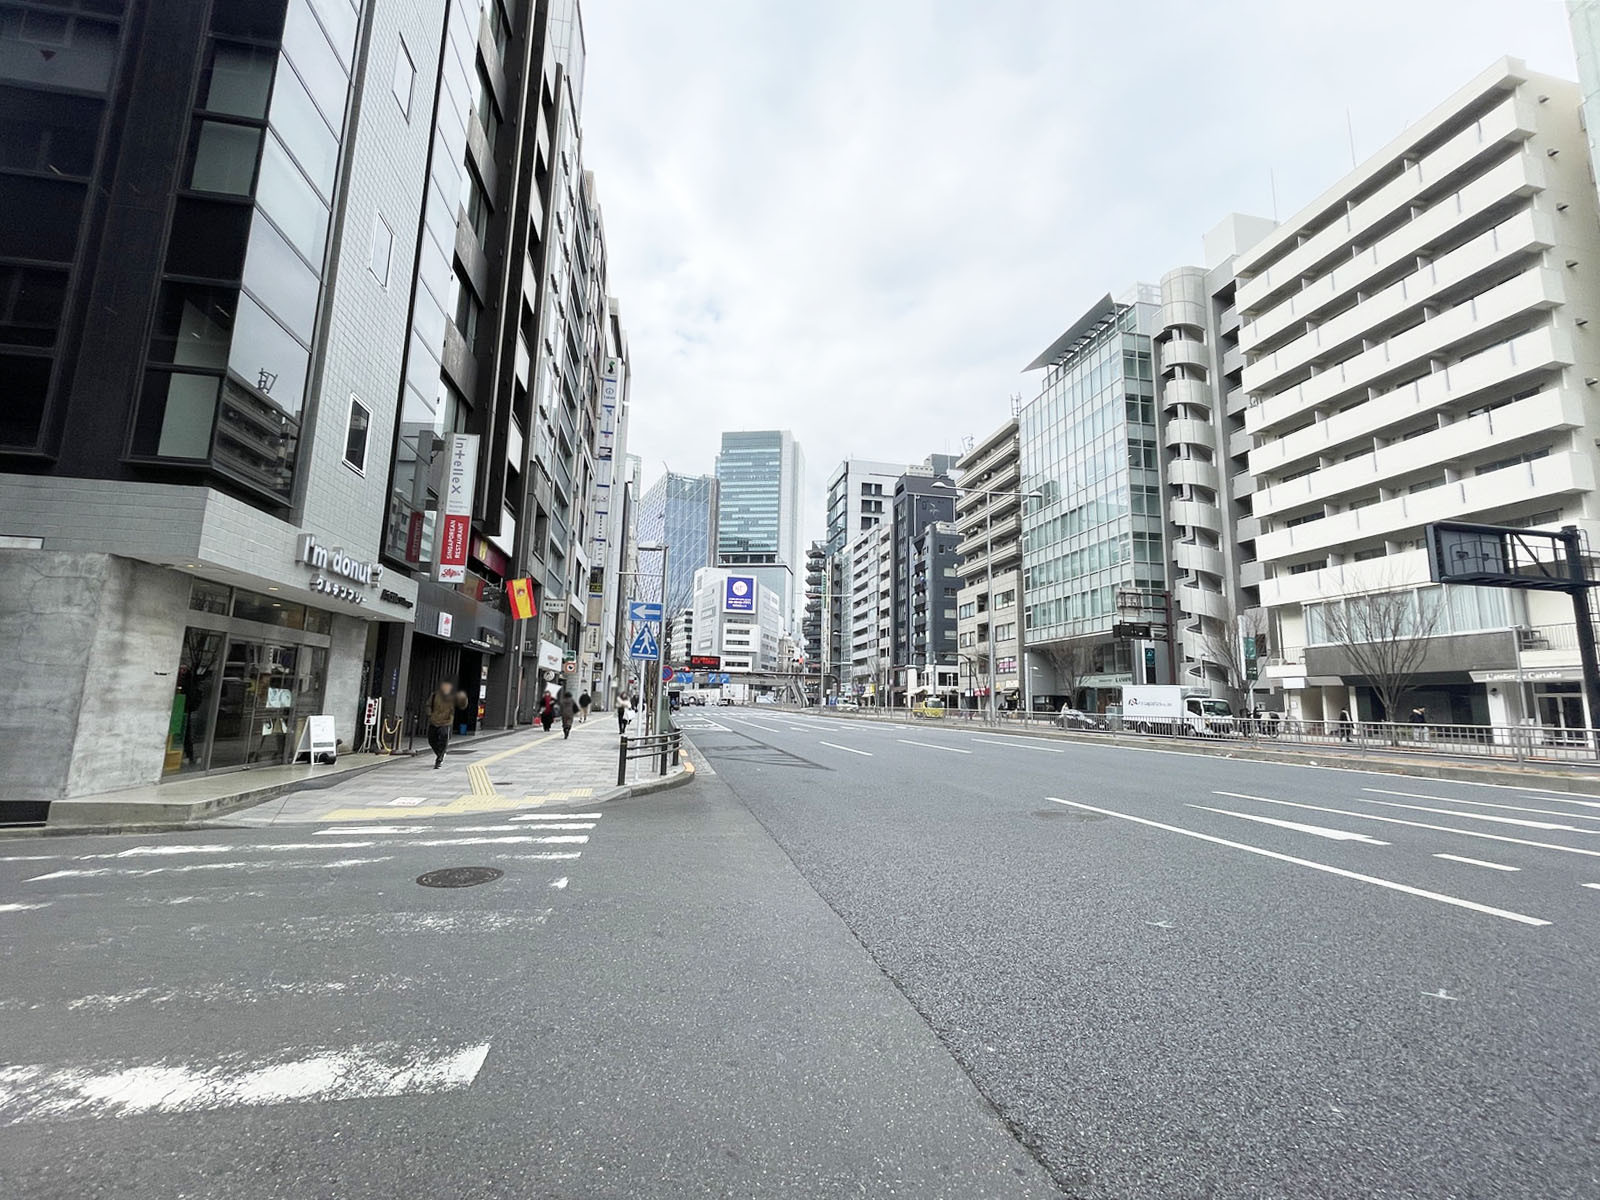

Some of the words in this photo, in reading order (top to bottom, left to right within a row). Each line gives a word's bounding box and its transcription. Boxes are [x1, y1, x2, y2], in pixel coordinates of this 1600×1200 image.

[303, 535, 328, 568] I'm
[333, 549, 372, 584] donut
[446, 519, 456, 560] SINGAPOREAN
[455, 522, 464, 559] RESTAURANT
